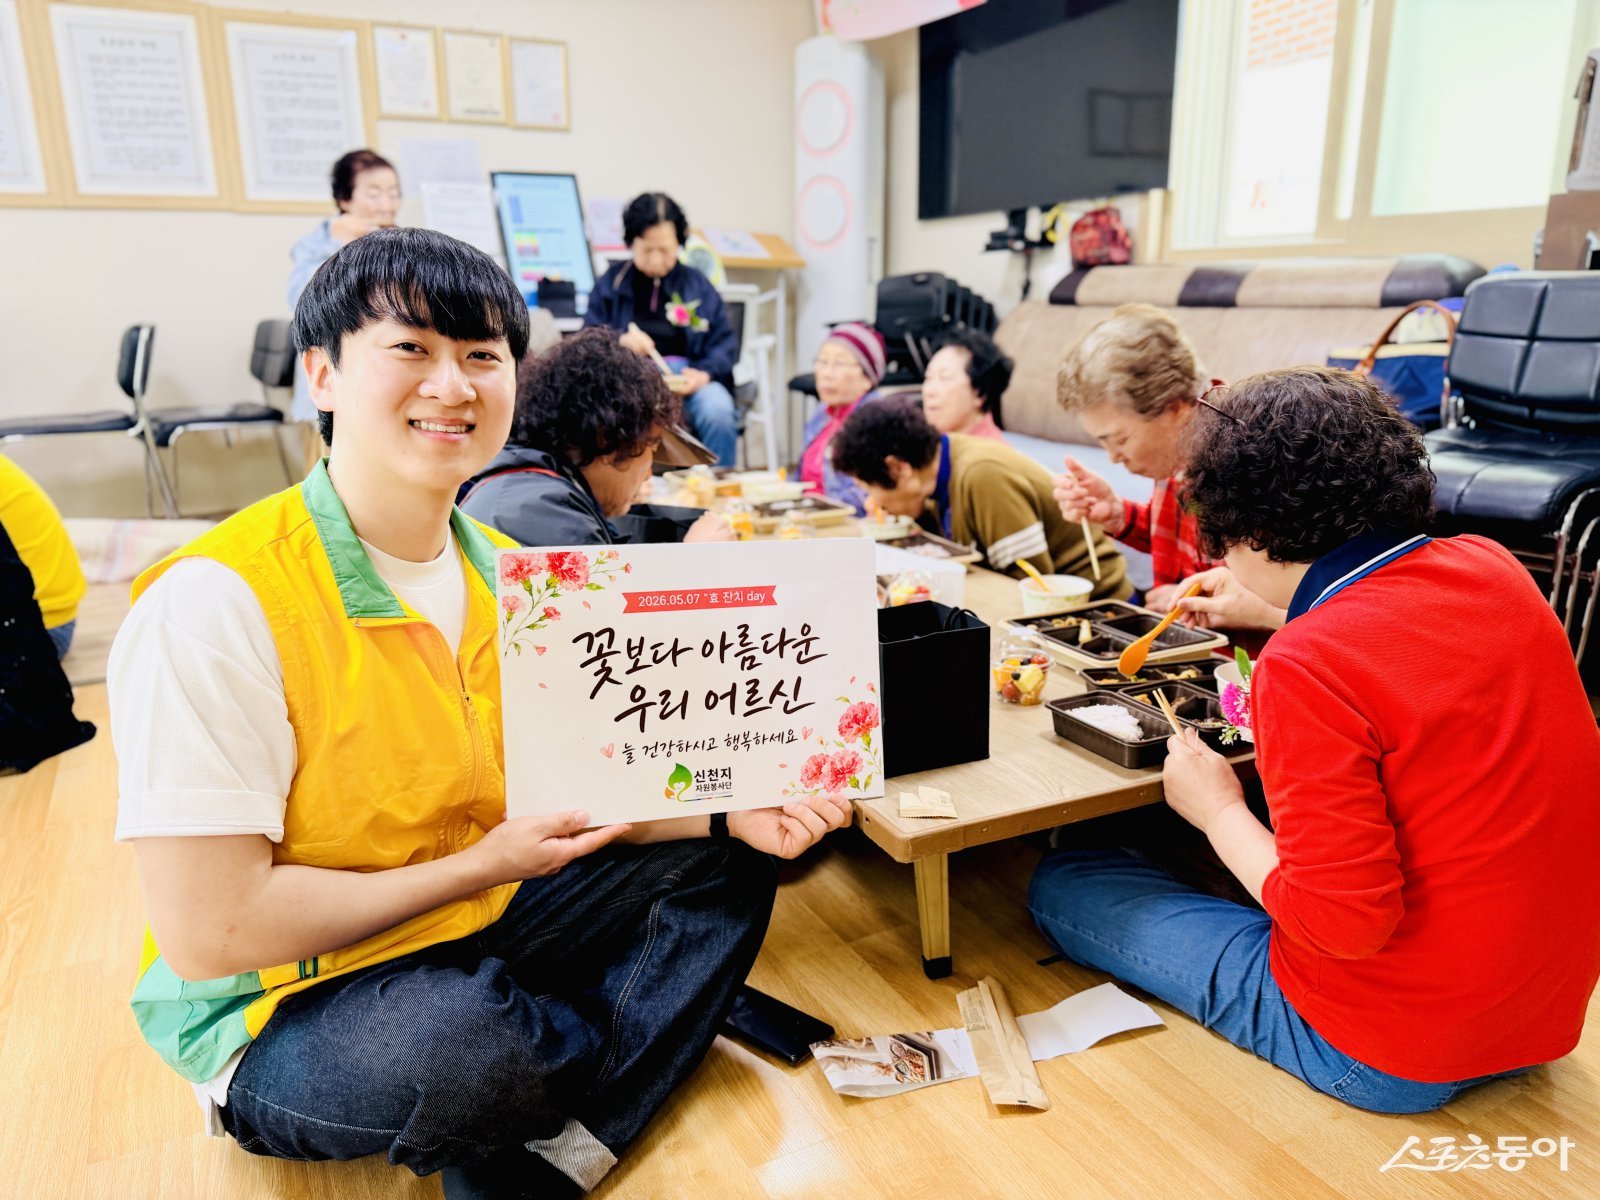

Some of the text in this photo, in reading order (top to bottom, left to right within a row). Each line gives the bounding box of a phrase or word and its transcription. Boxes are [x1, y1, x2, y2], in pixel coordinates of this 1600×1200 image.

[638, 593, 700, 607] 2026.05.07
[723, 591, 744, 604] 잔치
[747, 591, 765, 602] day
[572, 622, 829, 700] 꽃보다 아름다운
[614, 675, 816, 733] 우리 어르신
[622, 728, 799, 765] 늘 건강하시고 행복하세요
[694, 766, 732, 783] 신천지
[695, 781, 732, 792] 자원봉사단
